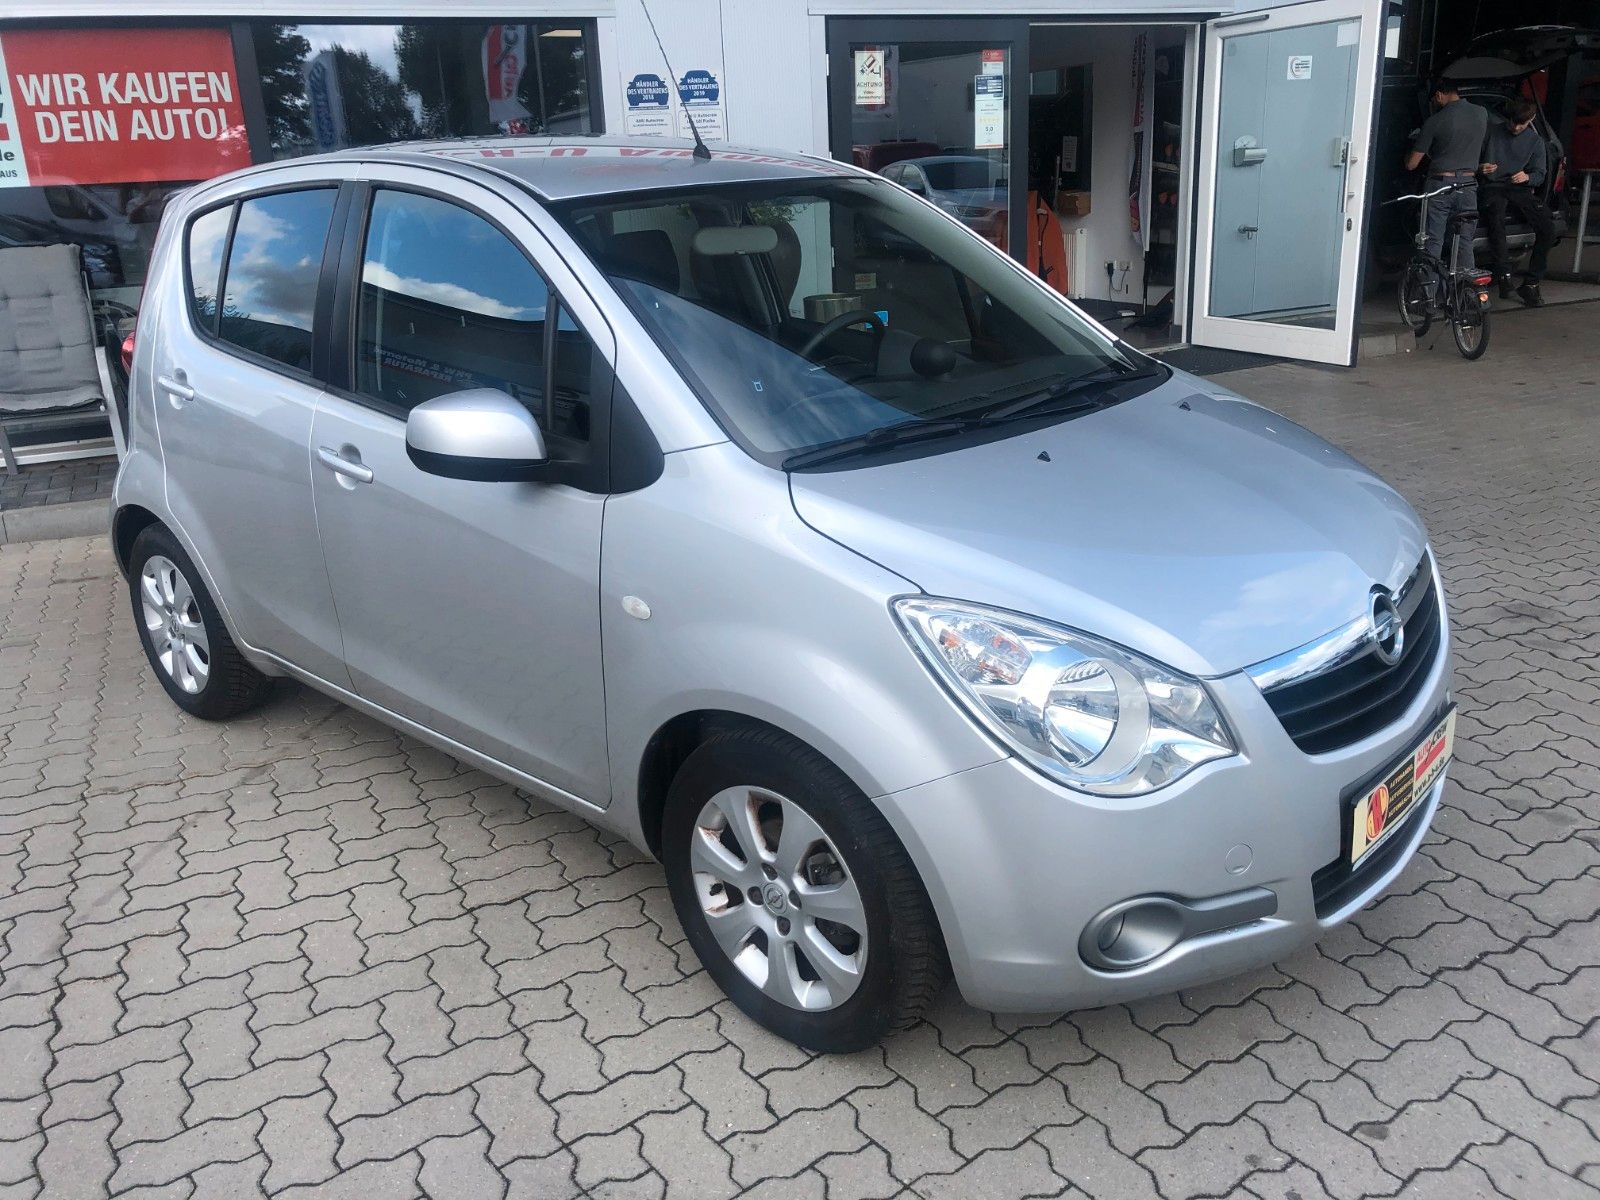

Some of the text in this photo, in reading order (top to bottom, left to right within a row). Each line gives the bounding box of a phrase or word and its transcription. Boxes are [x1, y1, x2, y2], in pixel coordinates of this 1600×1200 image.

[15, 71, 233, 106] WIR KAUFEN
[34, 108, 230, 144] DEIN AUTO!
